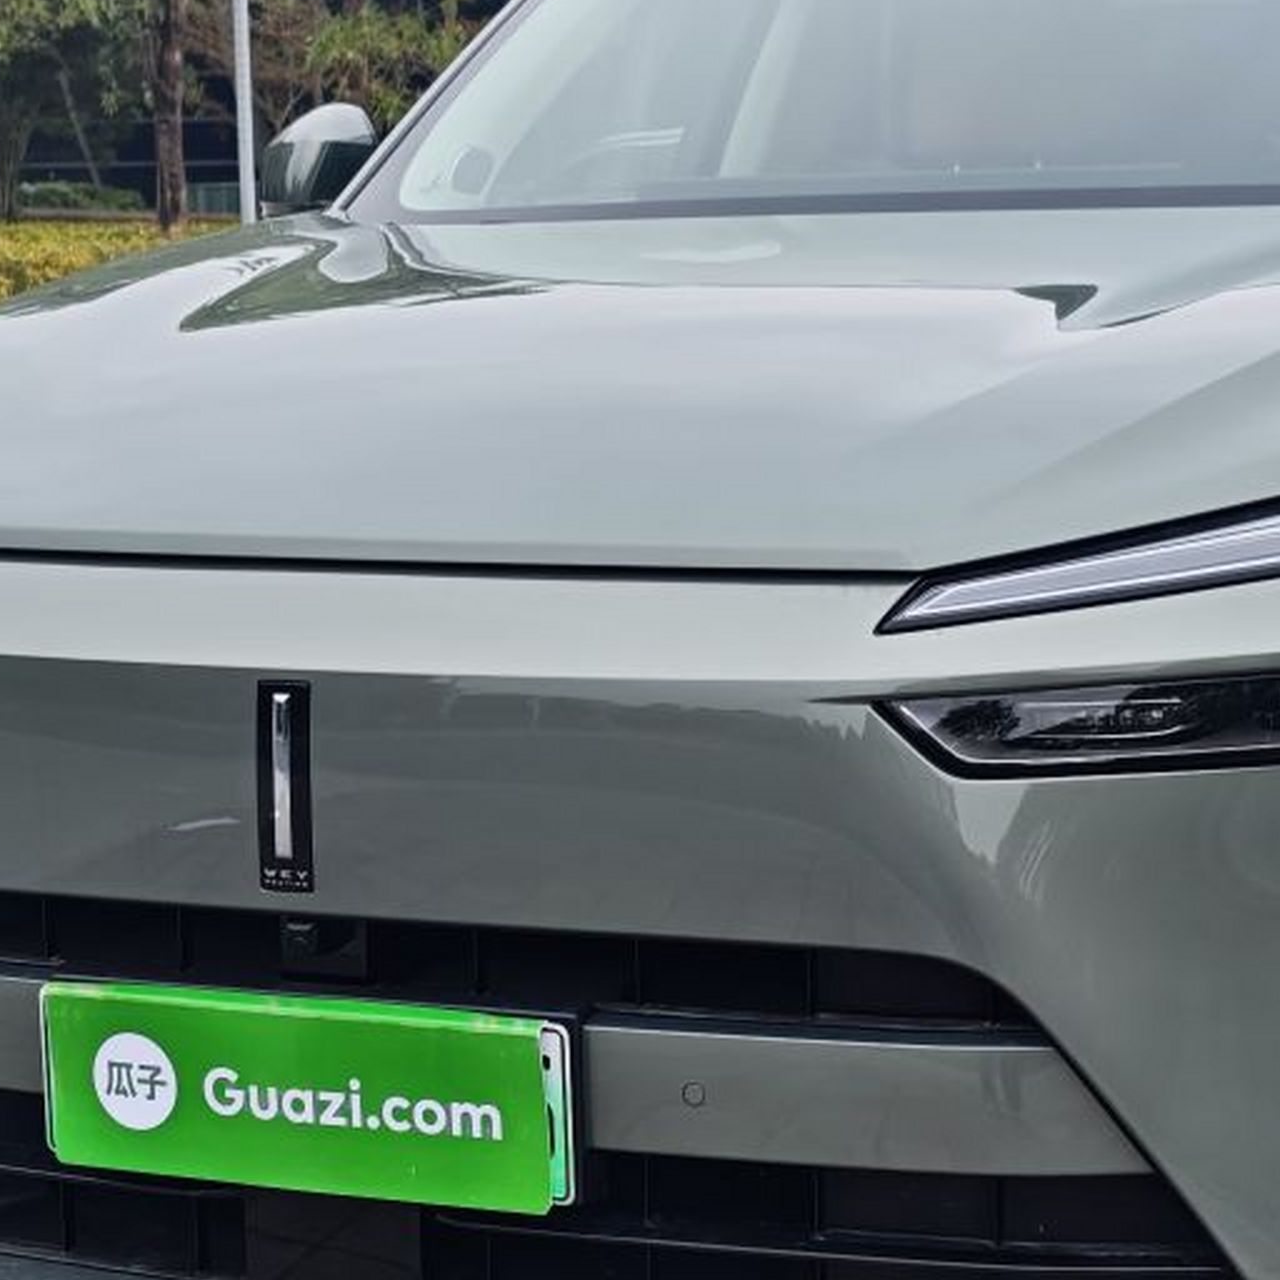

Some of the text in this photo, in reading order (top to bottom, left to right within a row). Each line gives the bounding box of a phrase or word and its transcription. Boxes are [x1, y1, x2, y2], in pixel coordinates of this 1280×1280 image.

[263, 868, 308, 880] WEY
[105, 1060, 168, 1101] 瓜子
[202, 1066, 504, 1141] Guazi.com
